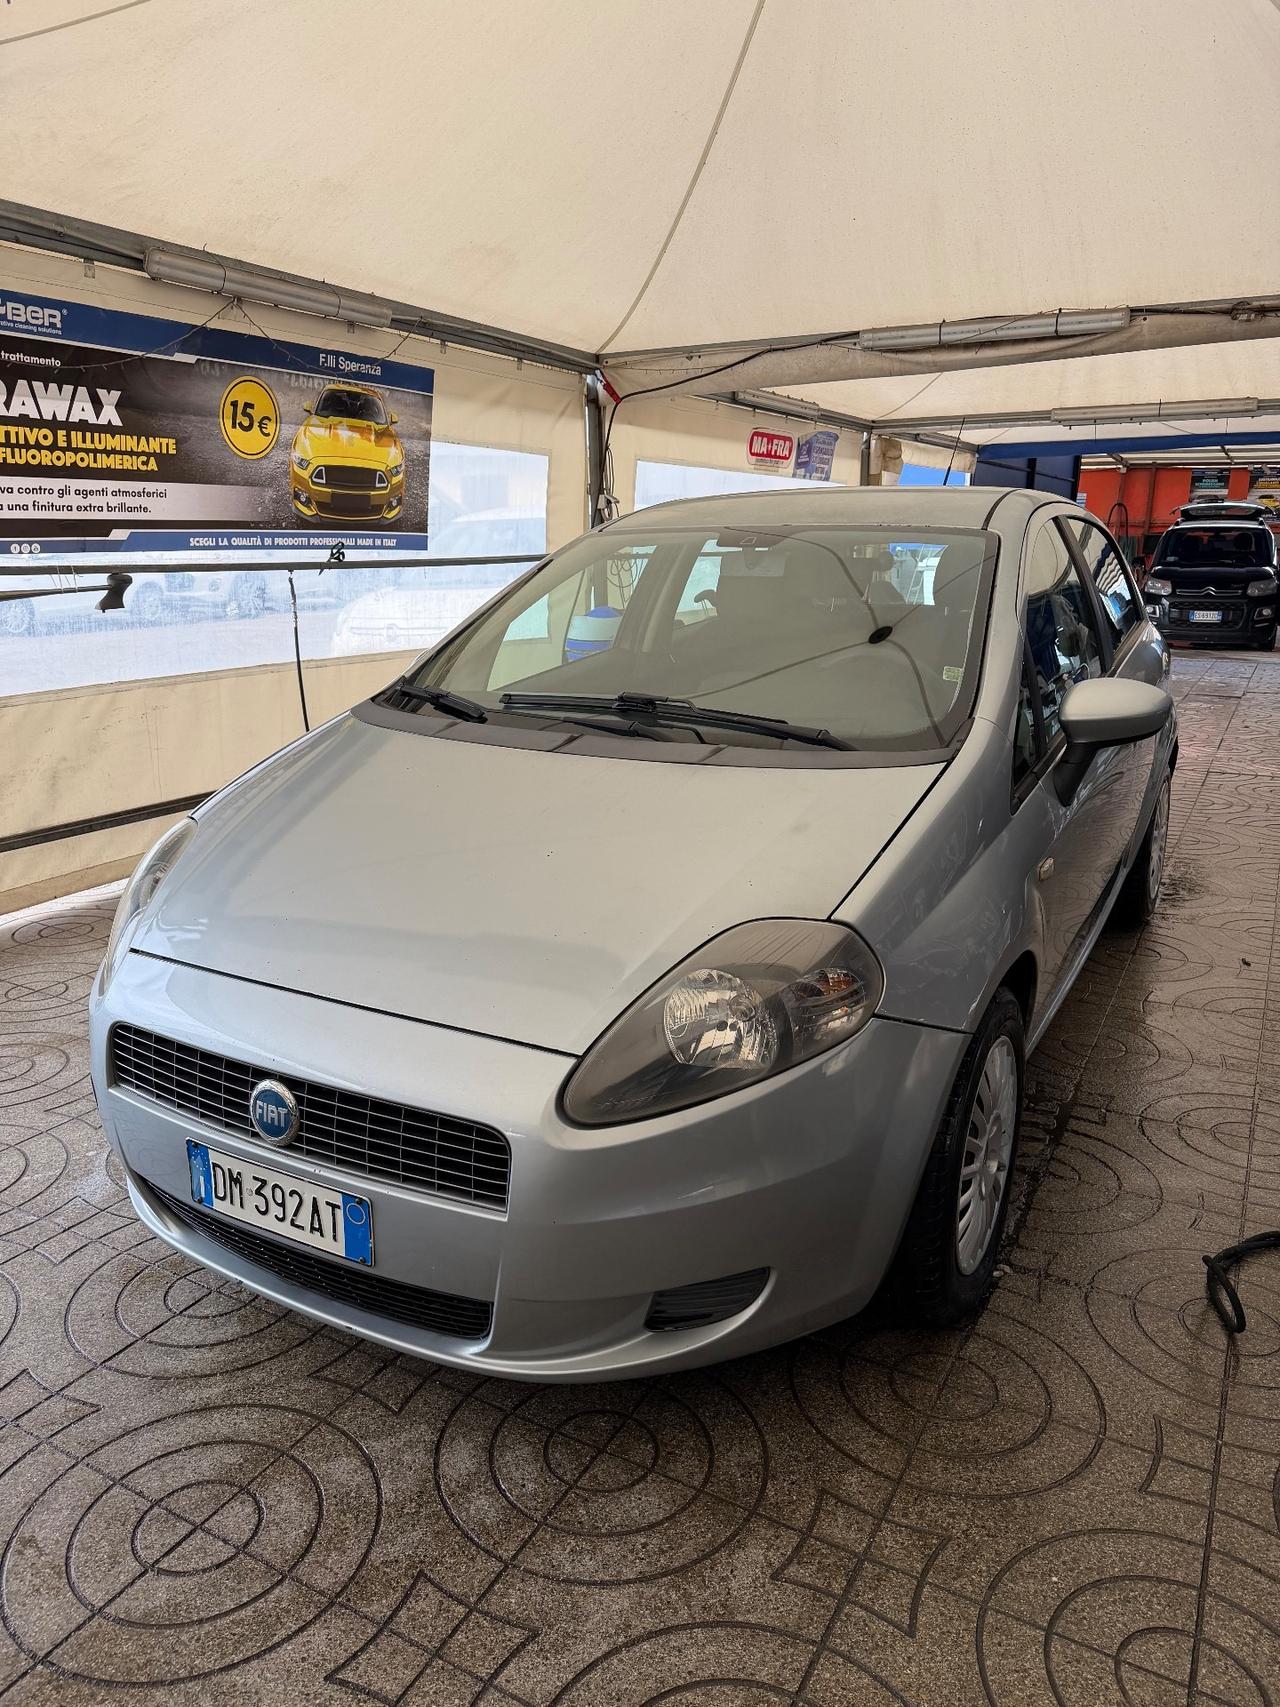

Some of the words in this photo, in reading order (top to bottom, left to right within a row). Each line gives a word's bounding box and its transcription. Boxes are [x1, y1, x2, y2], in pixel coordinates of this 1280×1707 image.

[15, 322, 37, 333] cleaning
[38, 326, 62, 335] solutions
[1, 349, 61, 367] trattamento
[338, 357, 382, 376] Speranza
[57, 430, 67, 447] E
[71, 431, 176, 455] ILLUMINANTE
[0, 447, 158, 471] FLUOROPOLIMERICA
[17, 485, 54, 496] contro
[57, 484, 71, 498] gli
[74, 486, 108, 499] agenti
[111, 487, 167, 499] atmosferici
[7, 503, 29, 512] una
[32, 500, 73, 512] finitura
[76, 503, 104, 513] extra
[106, 502, 152, 513] brillante.
[189, 537, 216, 547] SCEGLI
[218, 537, 229, 546] LA
[231, 535, 262, 547] QUALITÀ
[264, 537, 273, 546] DI
[274, 537, 308, 546] PRODOTTI
[357, 538, 373, 547] MADE
[374, 538, 382, 547] IN
[383, 538, 397, 547] ITALY
[256, 1100, 289, 1127] FIAT
